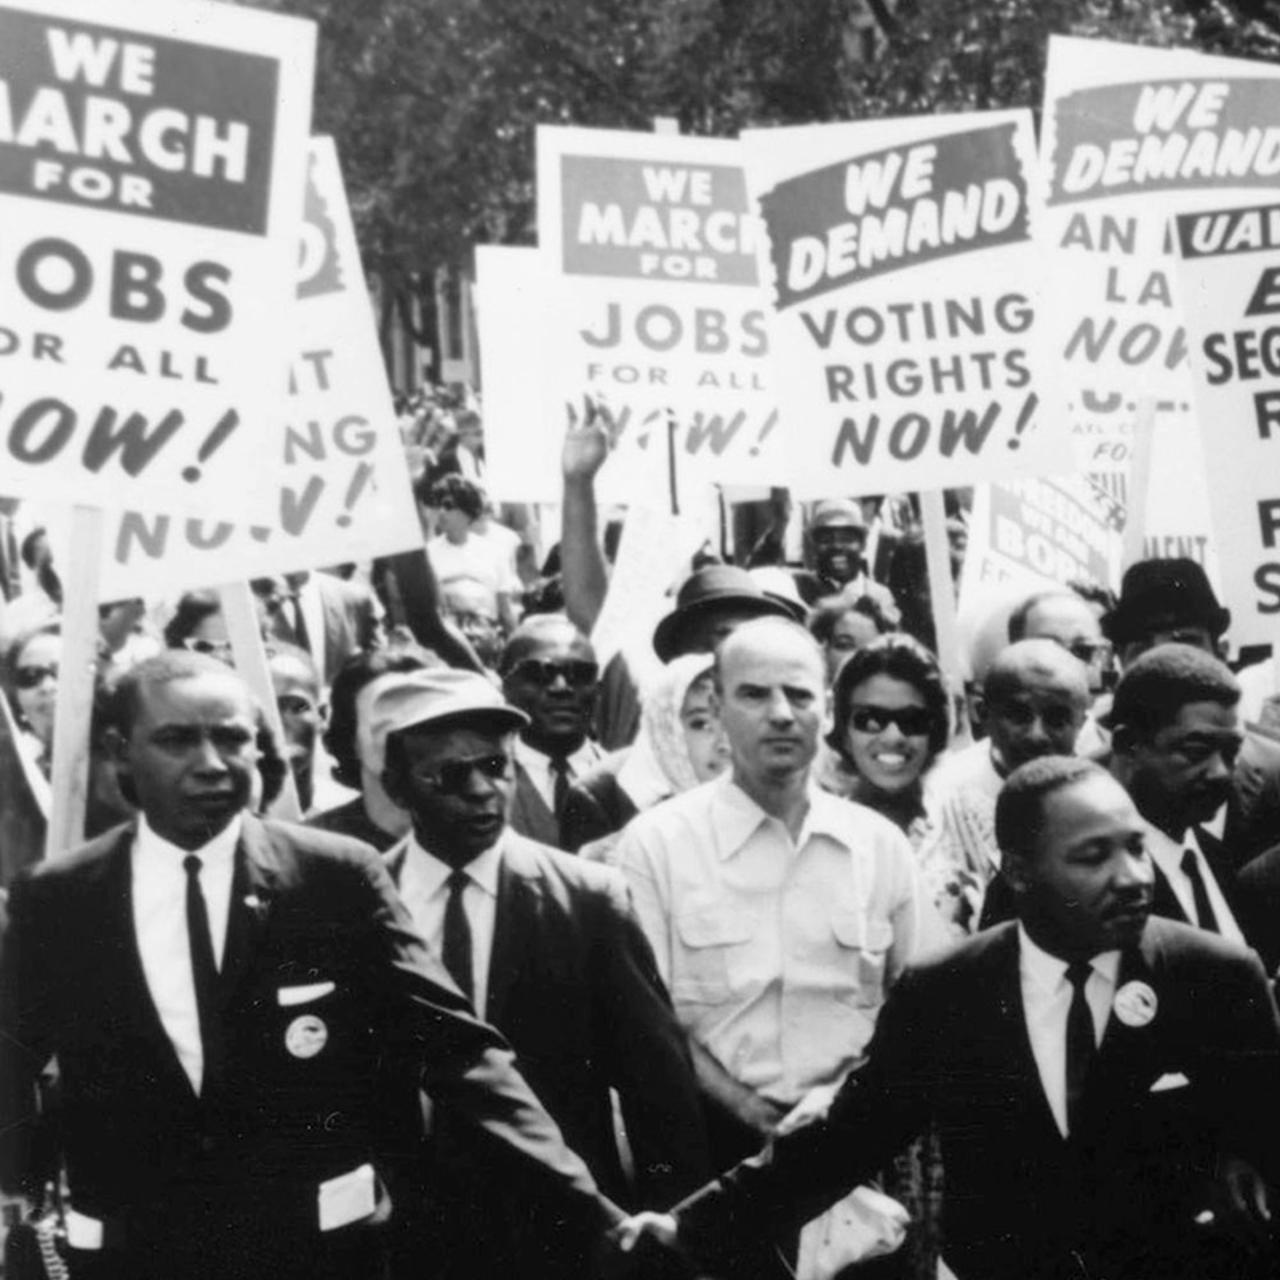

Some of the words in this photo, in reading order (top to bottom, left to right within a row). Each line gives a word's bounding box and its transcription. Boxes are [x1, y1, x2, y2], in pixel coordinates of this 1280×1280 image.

[46, 27, 157, 97] WE
[1132, 82, 1230, 134] WE
[32, 159, 154, 209] FOR
[642, 166, 713, 207] WE
[843, 144, 938, 215] WE
[786, 179, 1019, 293] DEMAND
[1060, 213, 1138, 256] AN
[14, 235, 234, 335] OBS
[638, 254, 719, 280] FOR
[1105, 266, 1176, 308] LA
[579, 301, 770, 359] JOBS
[799, 293, 1036, 350] VOTING
[0, 326, 66, 364] OR
[107, 343, 220, 386] ALL
[586, 362, 669, 385] FOR
[697, 369, 767, 391] ALL
[823, 350, 1032, 404] RIGHTS
[0, 395, 240, 484] OW!
[830, 391, 1040, 468] NOW!
